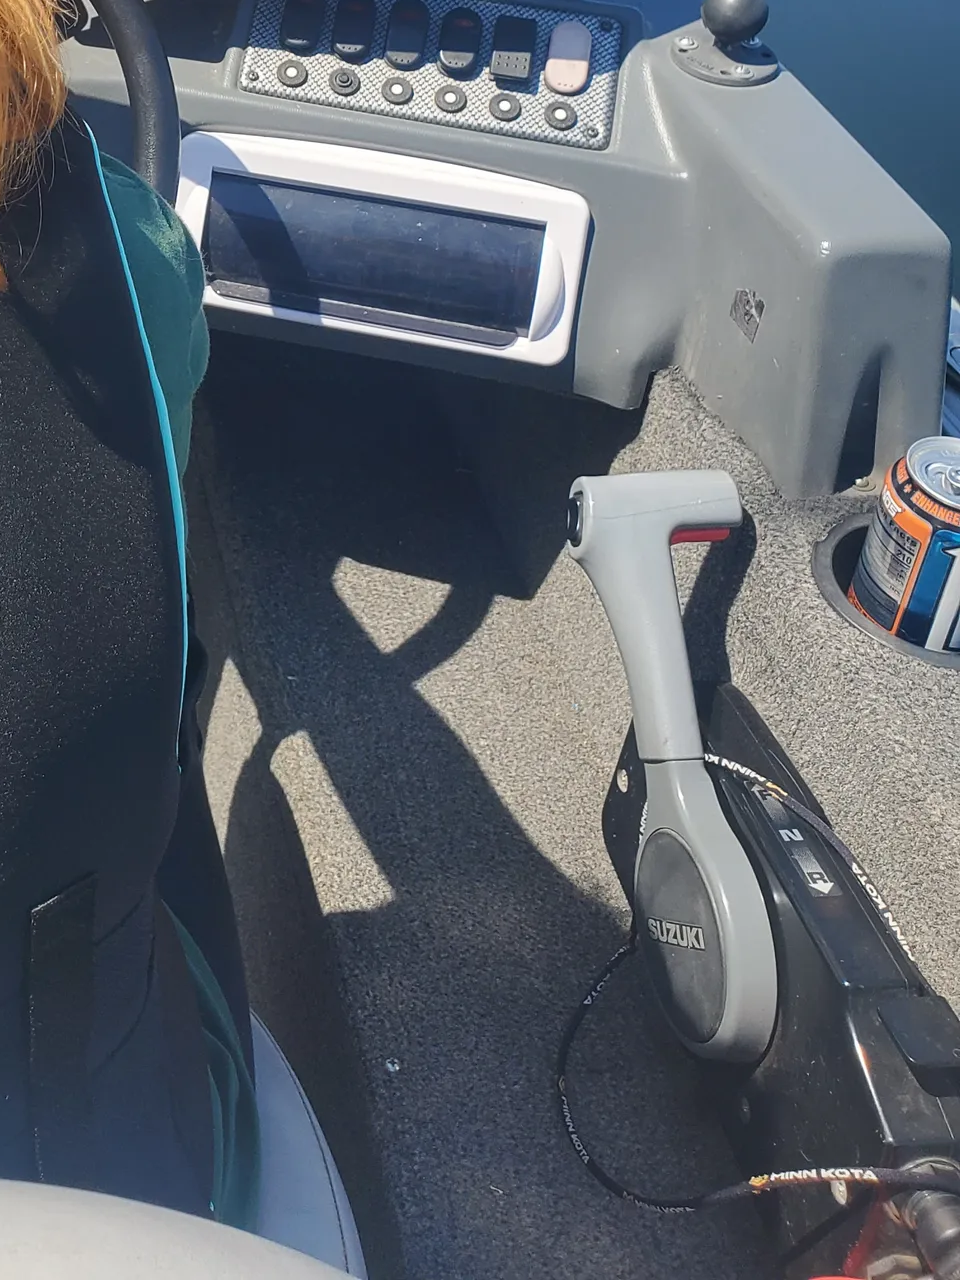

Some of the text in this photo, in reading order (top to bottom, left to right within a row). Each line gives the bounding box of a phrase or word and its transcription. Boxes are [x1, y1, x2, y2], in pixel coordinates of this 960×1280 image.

[896, 548, 913, 565] 210
[778, 828, 804, 841] N
[851, 862, 888, 910] KOTA
[646, 917, 707, 949] SUZUKI
[769, 1167, 879, 1181] MINN KOTA
